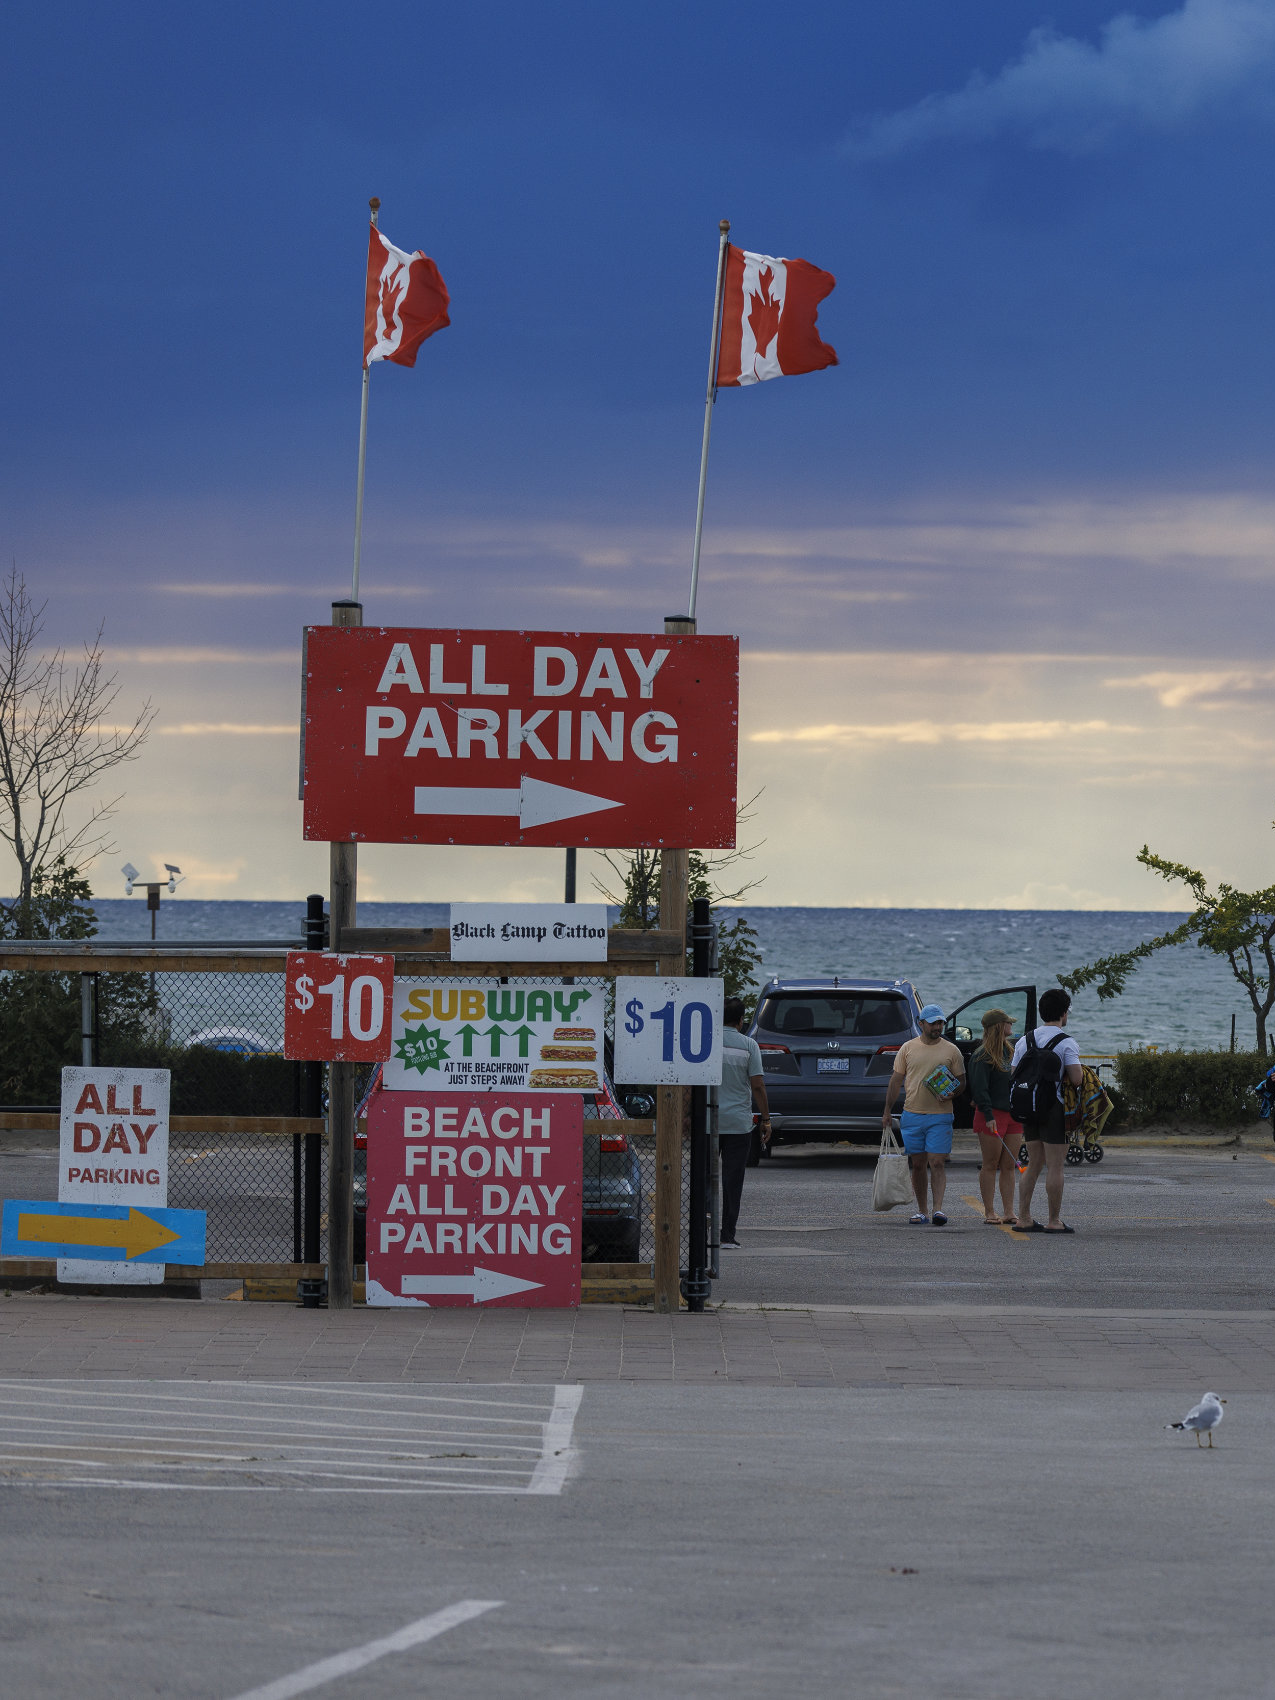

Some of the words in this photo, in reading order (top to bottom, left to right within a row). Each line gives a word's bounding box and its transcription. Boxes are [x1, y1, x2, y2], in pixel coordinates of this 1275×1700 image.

[376, 643, 509, 696] ALL
[533, 646, 671, 699] DAY
[364, 705, 679, 763] PARKING
[452, 922, 495, 941] Black
[501, 922, 547, 943] Lamp
[553, 922, 606, 939] Tattoo
[294, 974, 386, 1042] $10
[400, 988, 592, 1023] SUBWAY
[404, 1036, 438, 1058] $10
[624, 997, 714, 1065] $10
[444, 1062, 455, 1073] AT
[457, 1062, 472, 1073] THE
[475, 1062, 530, 1074] BEACHFRONT
[448, 1074, 469, 1085] JUST
[471, 1074, 498, 1085] STEPS
[500, 1075, 525, 1086] AWAY!
[74, 1083, 157, 1116] ALL
[403, 1106, 551, 1139] BEACH
[73, 1123, 159, 1155] DAY
[68, 1167, 160, 1185] PARKING
[405, 1146, 551, 1178] FRONT
[387, 1184, 468, 1216] ALL
[482, 1185, 567, 1217] DAY
[379, 1223, 573, 1255] PARKING
